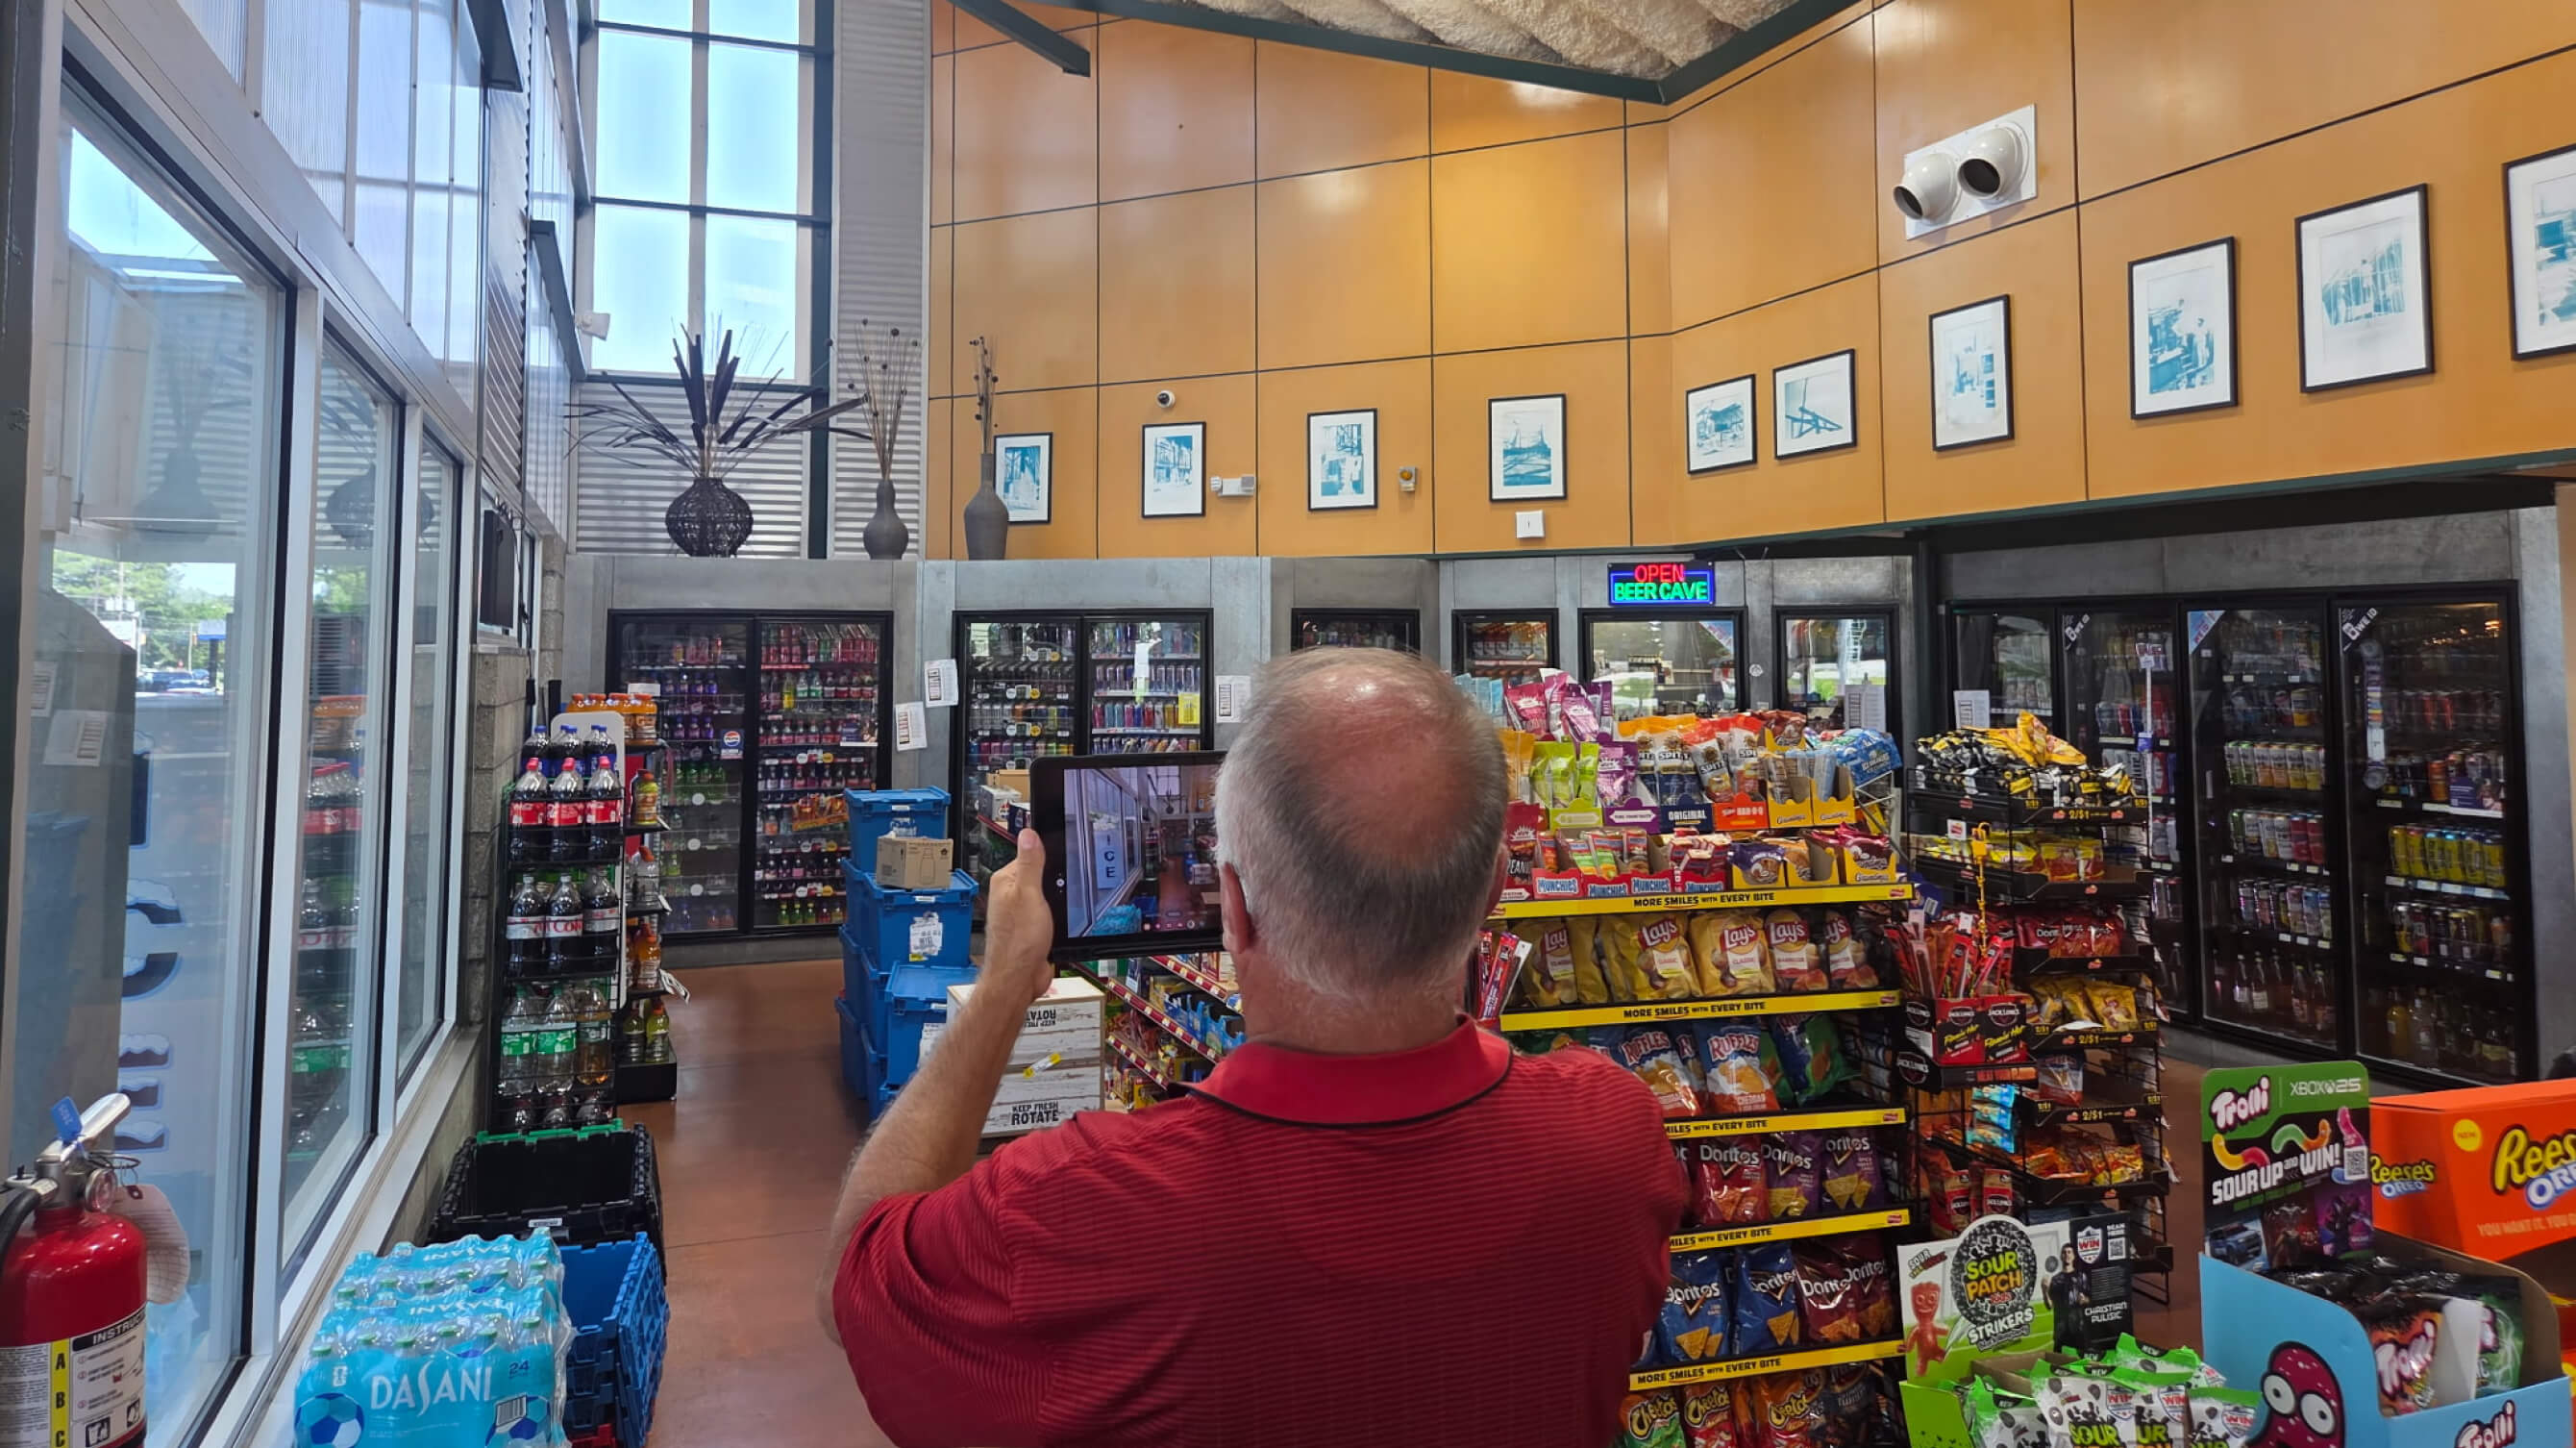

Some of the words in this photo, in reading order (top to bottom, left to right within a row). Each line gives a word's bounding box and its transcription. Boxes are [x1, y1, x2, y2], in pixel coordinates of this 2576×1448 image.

[1633, 563, 1686, 583] OPEN
[1614, 583, 1658, 601] BEER
[1659, 581, 1708, 600] CAVE
[1739, 749, 1758, 759] SPI
[2068, 810, 2090, 819] 2/$1
[1104, 834, 1116, 878] ICE
[1634, 898, 1662, 907] MORE
[1665, 896, 1698, 906] SMILES
[1720, 894, 1750, 903] EVERY
[1753, 892, 1774, 901] BITE
[1545, 929, 1568, 951] Lay
[1642, 920, 1677, 946] Lay's
[1724, 924, 1756, 948] Lay's
[1770, 921, 1805, 943] Lay's
[1825, 917, 1847, 943] y's
[1025, 1010, 1056, 1020] ROTAT
[1623, 1009, 1652, 1018] MORE
[1654, 1006, 1690, 1016] SMILES
[1711, 1003, 1742, 1012] EVERY
[1622, 1032, 1671, 1065] RUFFLES
[1707, 1034, 1760, 1061] RUFFLES
[2078, 1035, 2099, 1044] 2/$1
[2291, 1081, 2326, 1096] XBOX
[1012, 1104, 1032, 1113] KEEP
[2211, 1076, 2269, 1129] Trolli
[1011, 1109, 1059, 1126] ROTATE
[2082, 1111, 2103, 1121] 2/$1
[1665, 1125, 1691, 1135] MILES
[1712, 1121, 1743, 1131] EVERY
[1746, 1119, 1768, 1129] BITE
[1699, 1144, 1760, 1164] Doritos
[1826, 1136, 1870, 1152] oritos
[2212, 1169, 2259, 1205] SOUR
[2260, 1161, 2285, 1189] UP
[2299, 1142, 2341, 1175] WIN!
[2370, 1154, 2435, 1184] Reese's
[2380, 1182, 2426, 1198] OREO
[1718, 1231, 1747, 1241] EVERY
[1750, 1228, 1772, 1238] BITE
[2477, 1223, 2503, 1236] YOU
[2079, 1240, 2100, 1250] WIN
[1845, 1261, 1885, 1283] Dorito
[1966, 1251, 2019, 1280] SOUR
[1966, 1269, 2023, 1304] PATCH
[2084, 1301, 2128, 1316] CHRISTIAN
[93, 1309, 146, 1345] INSTRUC
[1968, 1308, 2035, 1344] STRIKERS
[2084, 1353, 2098, 1361] NEW
[2142, 1345, 2160, 1357] NEW
[2375, 1321, 2434, 1394] Trolli
[56, 1353, 66, 1370] A
[508, 1360, 529, 1374] 24
[1638, 1373, 1668, 1385] MORE
[1669, 1367, 1705, 1381] SMILES
[1725, 1361, 1757, 1373] EVERY
[1759, 1359, 1782, 1368] BITE
[370, 1361, 493, 1417] DASANI
[56, 1392, 65, 1410] B
[1771, 1394, 1809, 1426] Ceeto
[2163, 1395, 2185, 1406] WIN
[2225, 1414, 2254, 1427] WIN
[2456, 1401, 2514, 1448] Trolli
[56, 1430, 65, 1448] C
[2069, 1422, 2119, 1446] SOUR
[2137, 1423, 2167, 1443] UR
